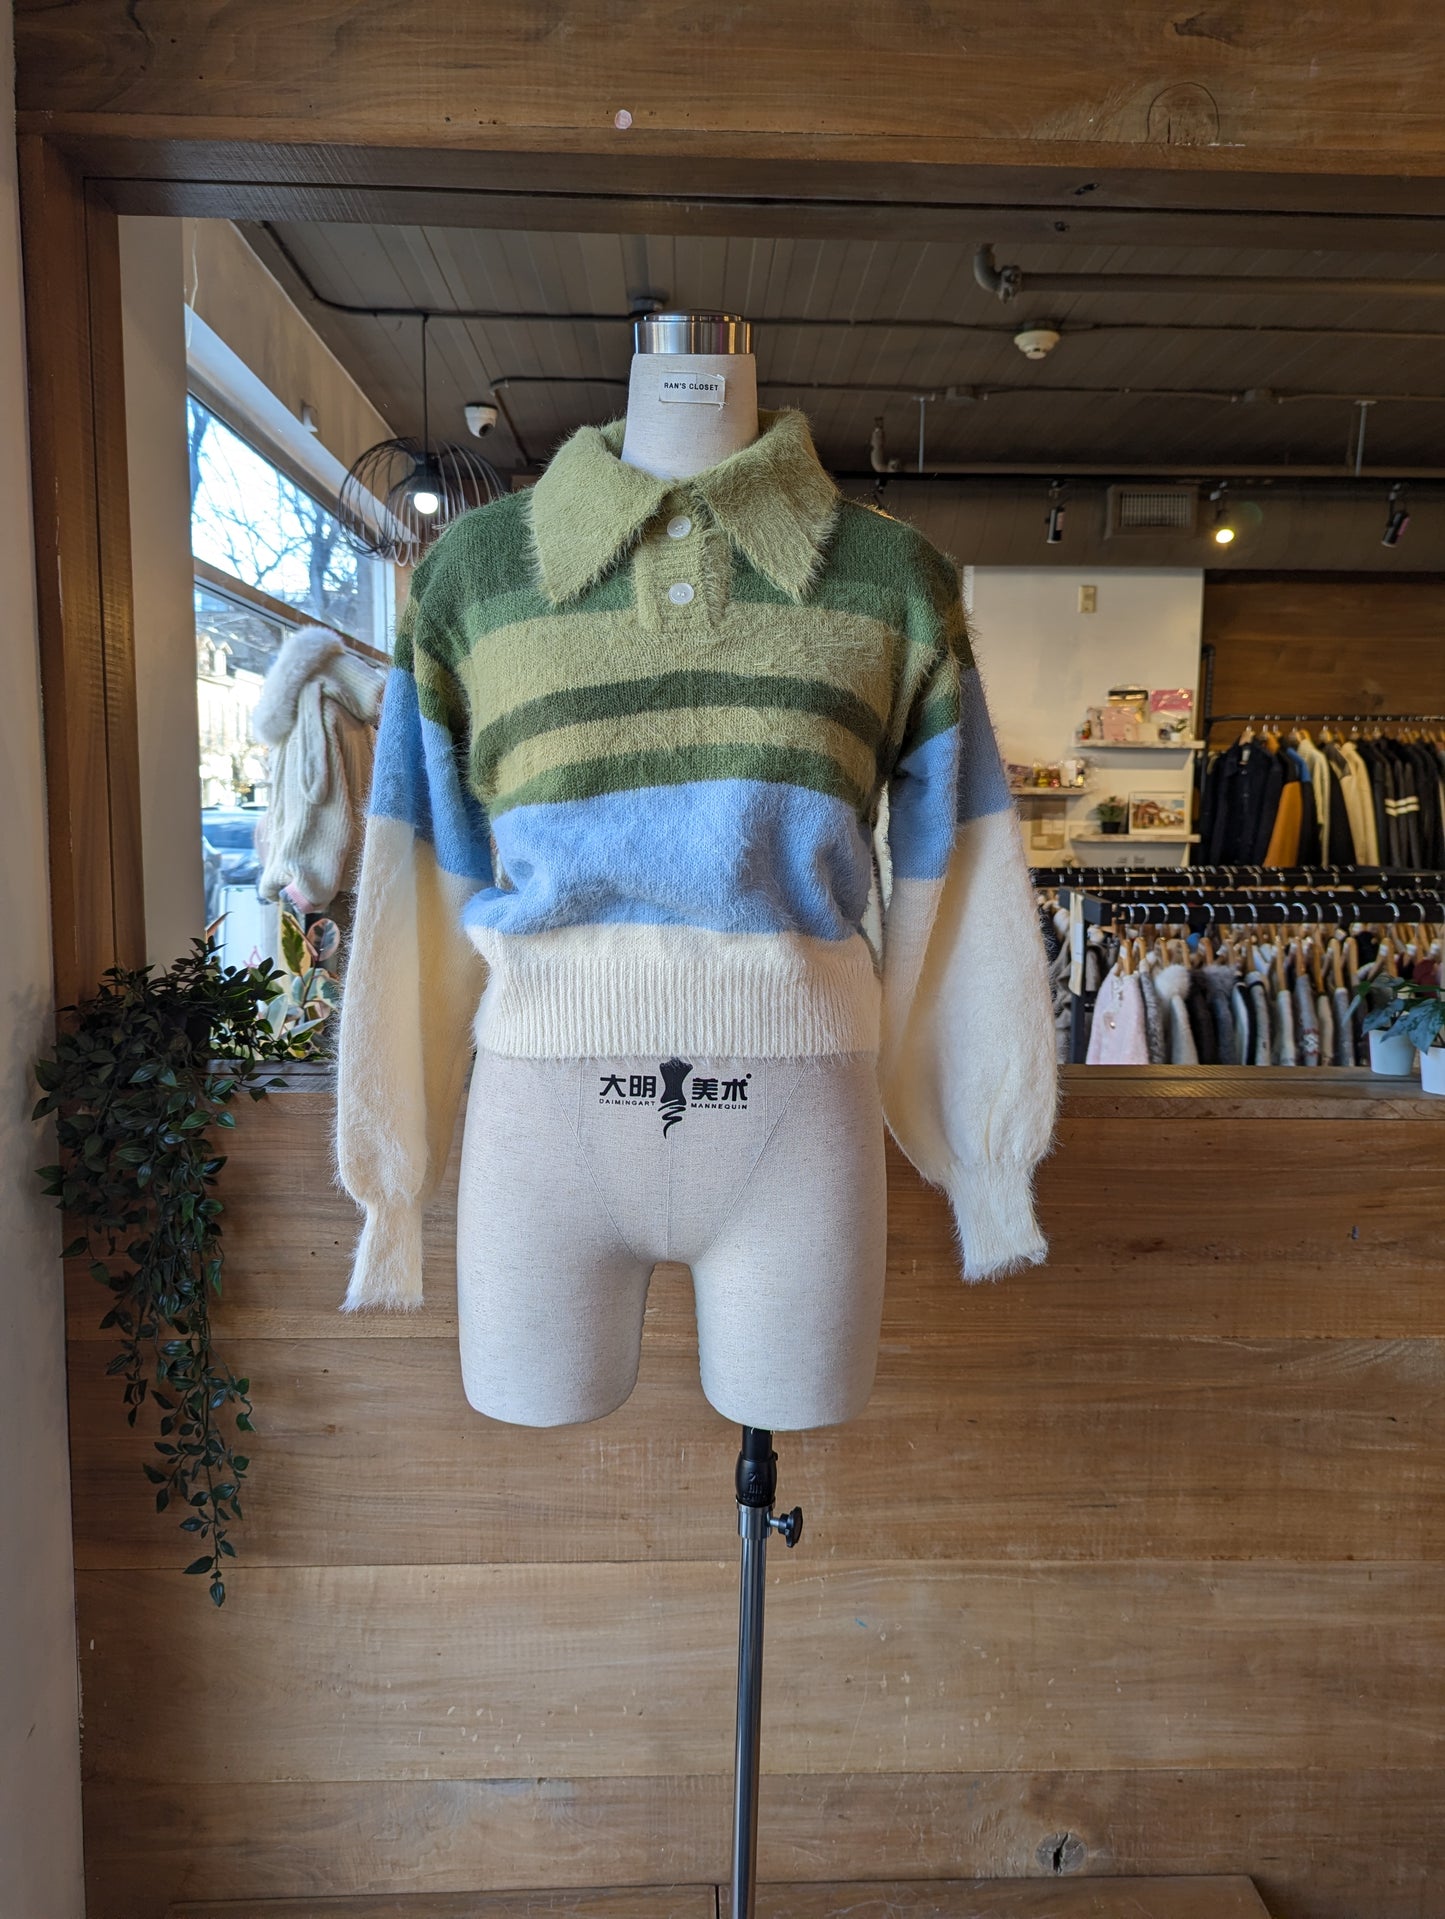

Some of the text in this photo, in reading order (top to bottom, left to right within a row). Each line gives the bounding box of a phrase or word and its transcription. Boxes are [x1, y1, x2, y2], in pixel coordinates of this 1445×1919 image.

[663, 382, 719, 391] RAN'S CLOSET
[599, 1074, 748, 1101] 大明 美术
[599, 1098, 748, 1110] DAIMINGART MANNEQUIN
